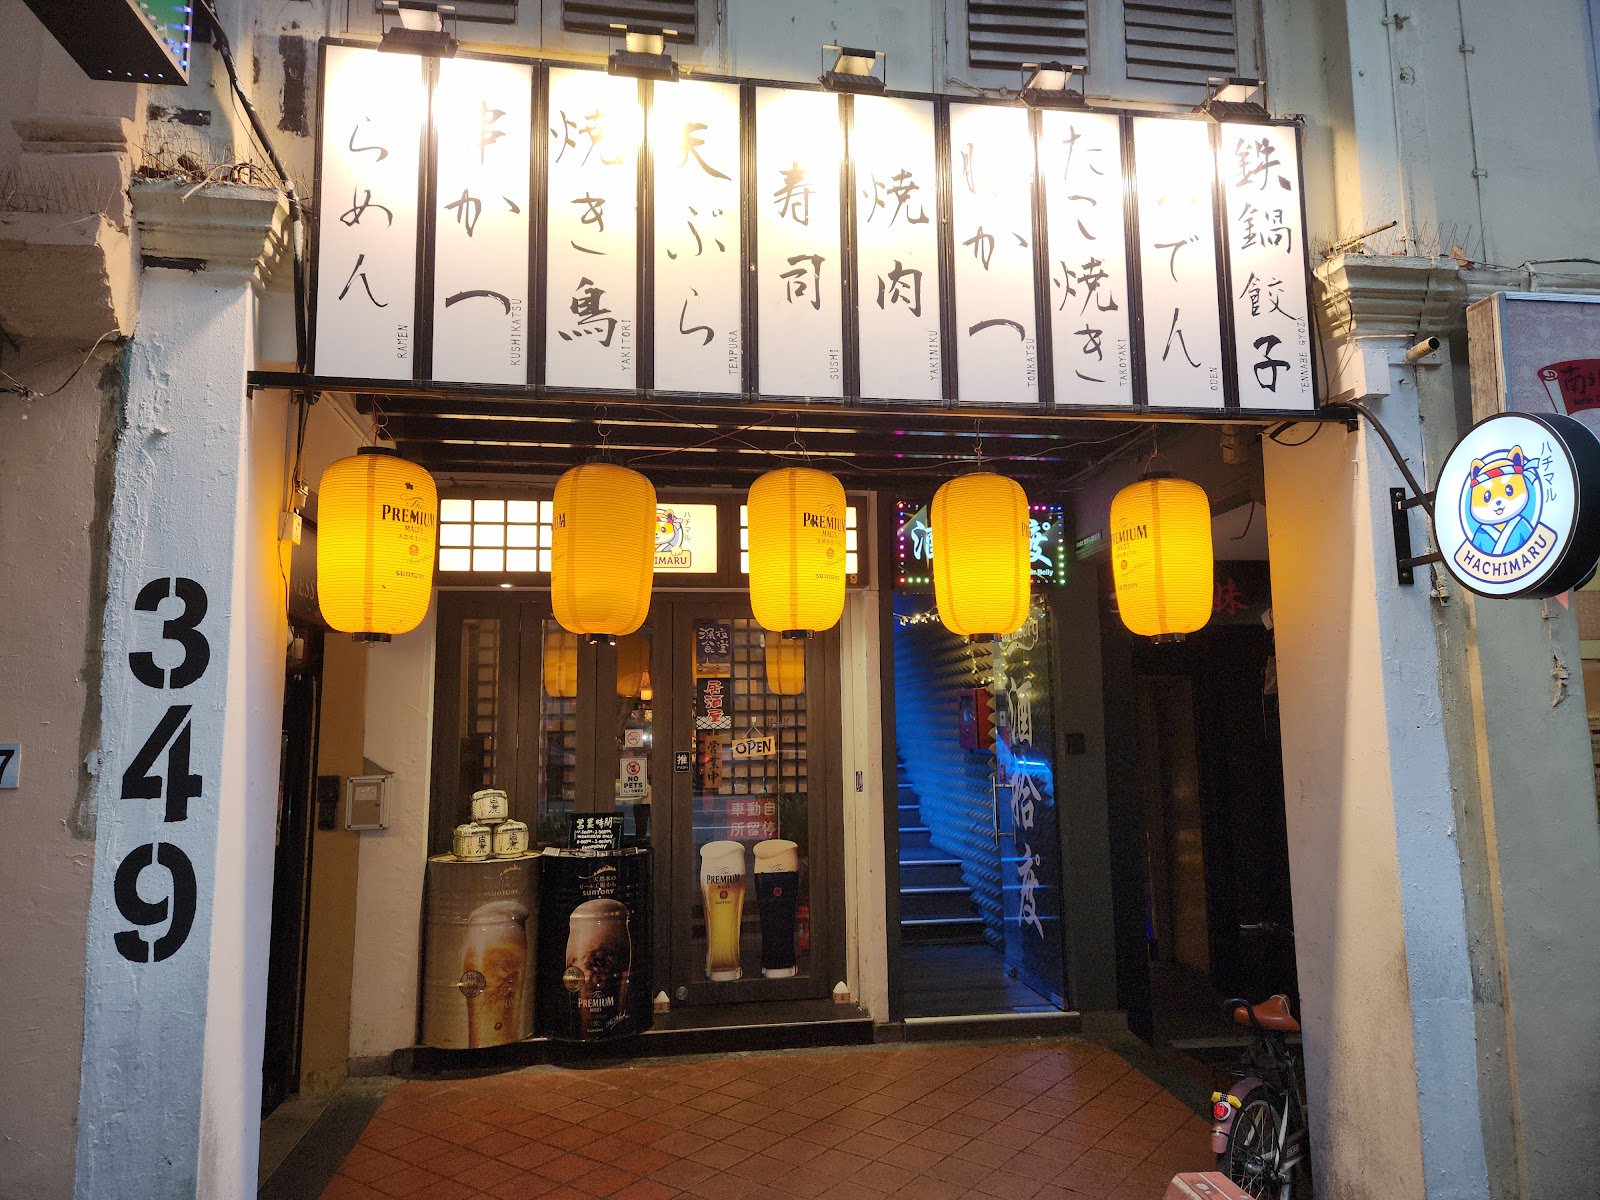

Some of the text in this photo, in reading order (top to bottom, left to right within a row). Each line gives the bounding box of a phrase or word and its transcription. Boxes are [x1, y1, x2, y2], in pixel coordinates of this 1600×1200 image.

[339, 115, 394, 309] らめん
[444, 100, 521, 315] 串かつ
[549, 107, 623, 348] 焼き鳥
[773, 161, 824, 311] 寿司
[861, 168, 930, 318] 焼肉
[1052, 125, 1119, 384] たこ焼き
[397, 324, 408, 359] RAMEN
[510, 298, 522, 366] KUSHIKATSU
[621, 319, 631, 371] YAKITORI
[728, 330, 739, 375] TENPURA
[1296, 316, 1310, 393] TENNABE GYOZA
[829, 348, 839, 380] SUSHI
[928, 330, 939, 381] YAKINIKU
[1025, 338, 1036, 387] TONKATSU
[1118, 338, 1128, 387] TAKOYAKI
[1209, 367, 1219, 391] ODEN
[1540, 441, 1557, 503] ハチマル
[382, 504, 434, 529] PREMIUM
[684, 511, 692, 541] ハチマル
[654, 556, 688, 565] IMARU
[1463, 533, 1547, 576] HACHIMARU
[698, 627, 729, 641] 深夜
[701, 640, 730, 654] 食堂
[703, 681, 724, 723] 居酒屋
[114, 577, 210, 962] 349
[676, 754, 688, 765] 推
[735, 739, 771, 755] OPEN
[706, 874, 740, 884] PREMIUM
[578, 996, 614, 1008] PREMIUM
